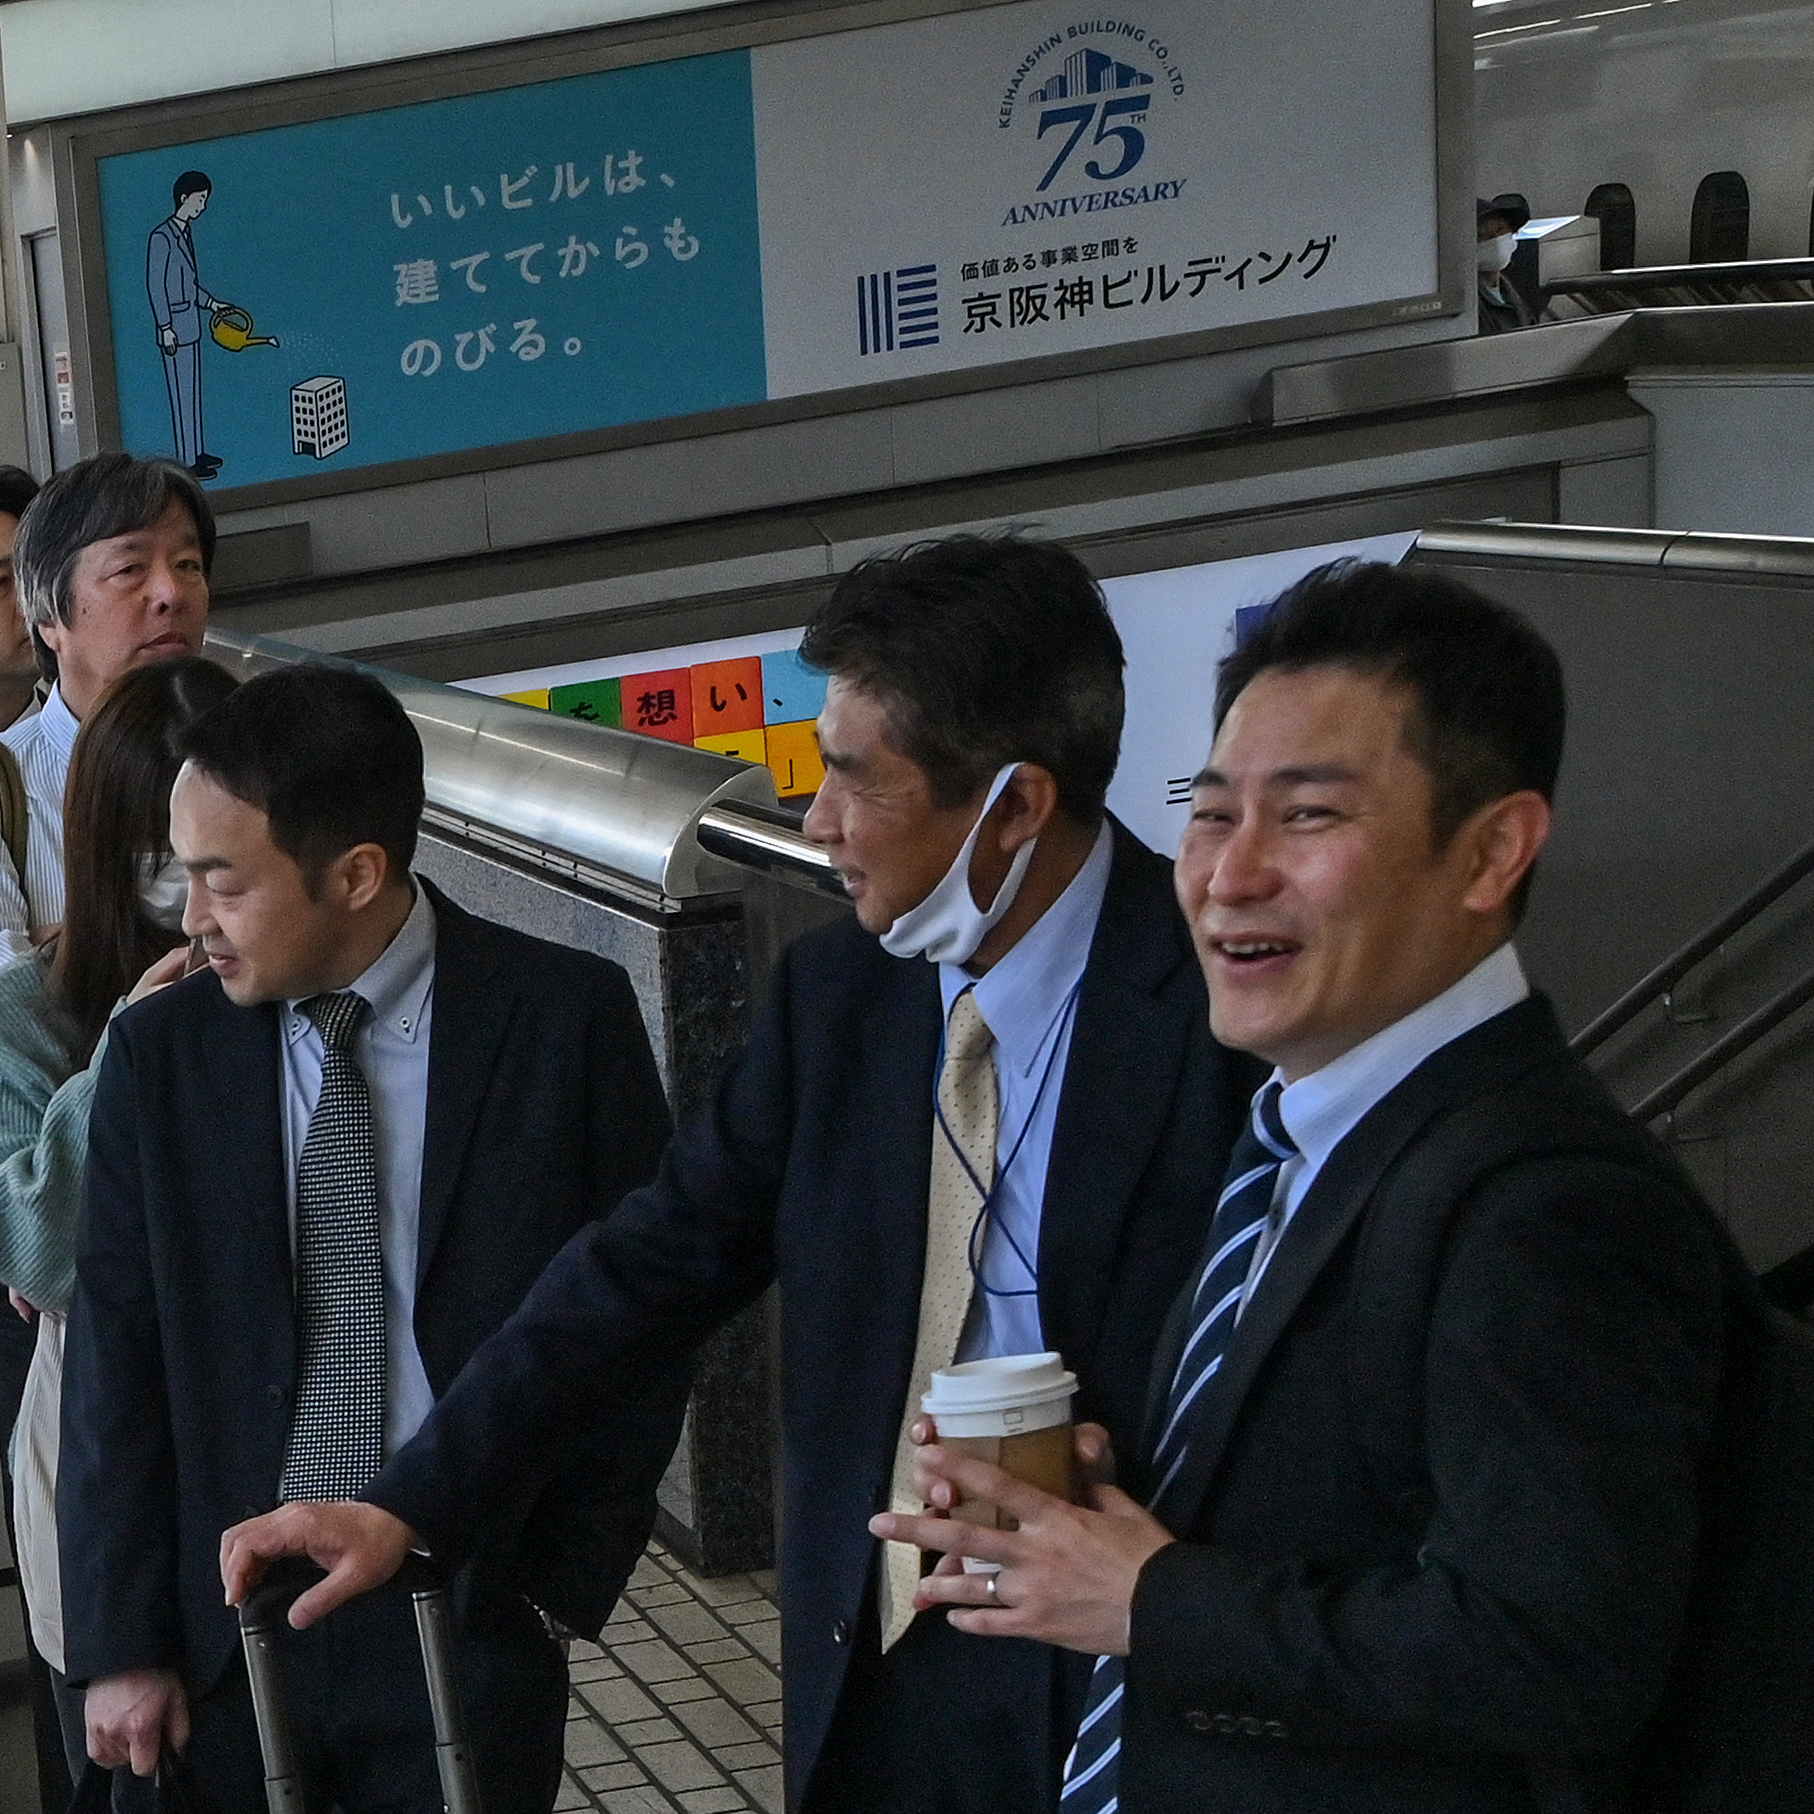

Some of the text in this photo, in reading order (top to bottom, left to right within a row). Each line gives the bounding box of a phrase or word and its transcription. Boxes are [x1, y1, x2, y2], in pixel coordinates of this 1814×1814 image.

[998, 33, 1063, 129] KEIHANSHIN
[1067, 20, 1147, 42] BUILDING
[390, 149, 676, 229] いいビルは、
[1001, 178, 1188, 227] ANNIVERSARY
[393, 217, 700, 307] 建ててからも
[959, 236, 1139, 282] 価値ある事業空間を
[960, 234, 1338, 335] 京阪神ビルディング
[400, 317, 584, 377] のびる。
